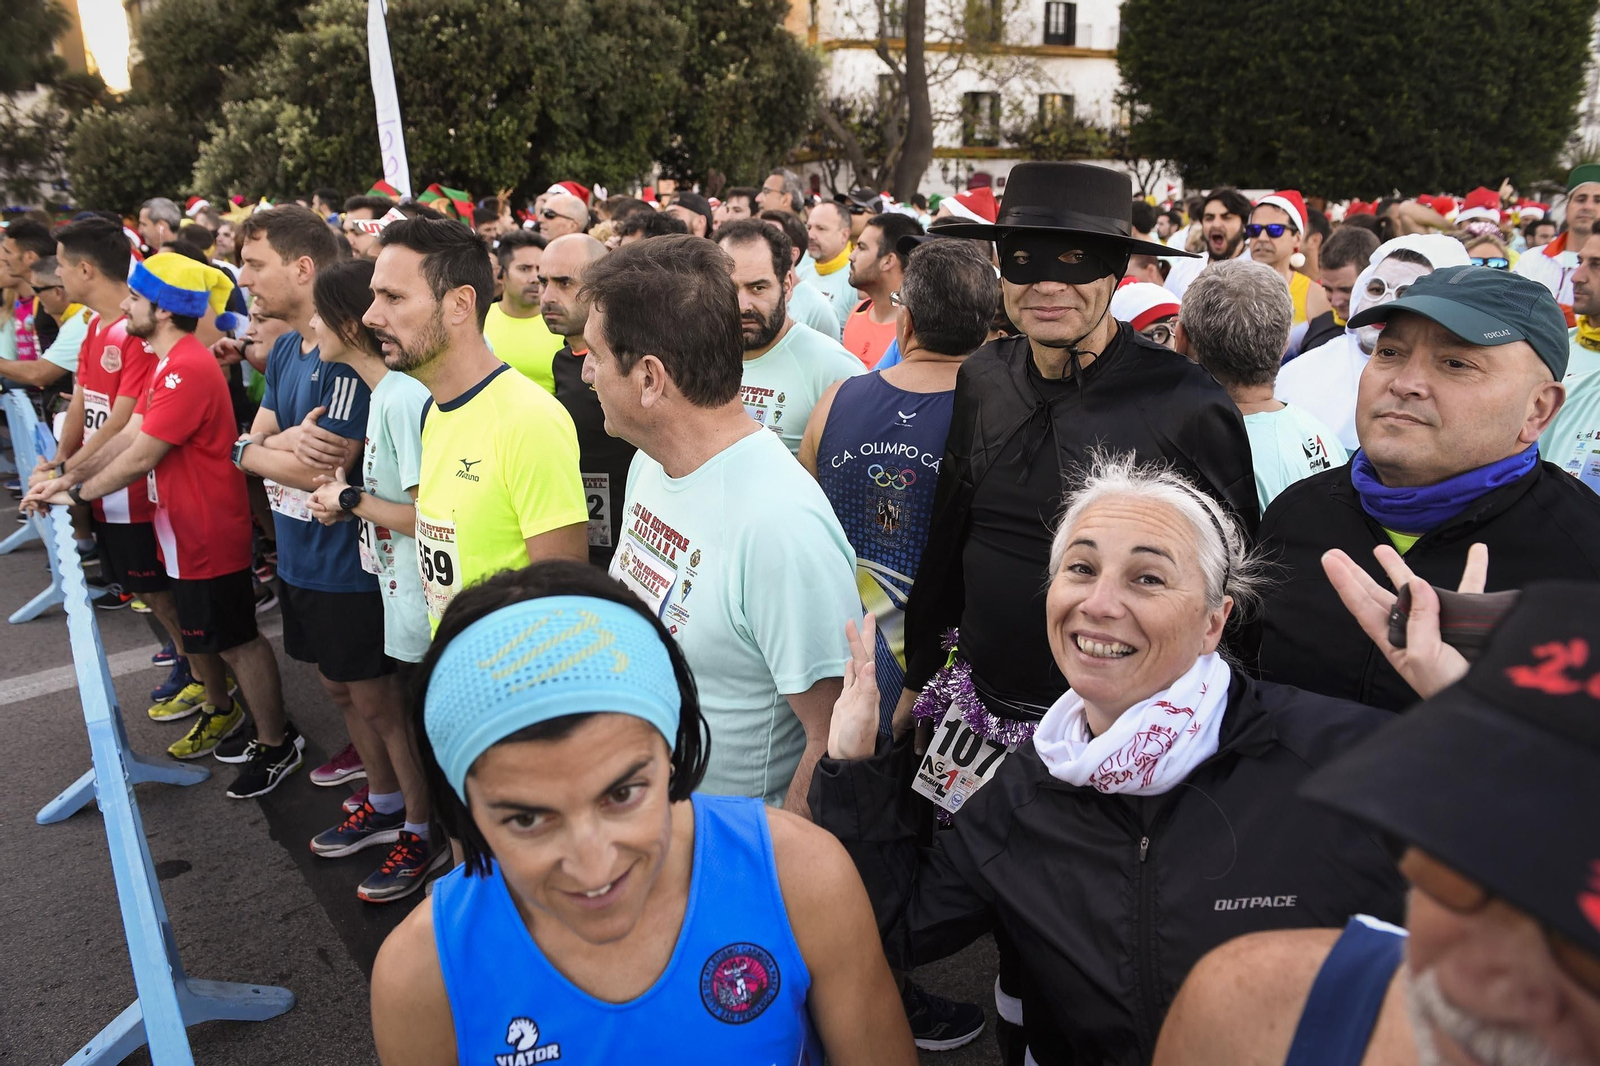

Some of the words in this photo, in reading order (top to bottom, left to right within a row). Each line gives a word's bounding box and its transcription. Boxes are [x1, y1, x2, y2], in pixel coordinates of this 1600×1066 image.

[1483, 329, 1511, 339] FORCLAZ
[831, 450, 857, 468] C.A.
[860, 441, 919, 459] OLIMPO
[633, 519, 677, 561] GADITANA
[640, 507, 653, 525] SAN
[650, 515, 691, 553] SILVESTRE
[632, 565, 661, 593] GADITANA
[643, 564, 671, 590] SILVESTRE
[181, 629, 205, 637] ELME
[937, 718, 1008, 778] 107
[1214, 895, 1298, 911] OUTPACE
[495, 1043, 560, 1066] VIATOR
